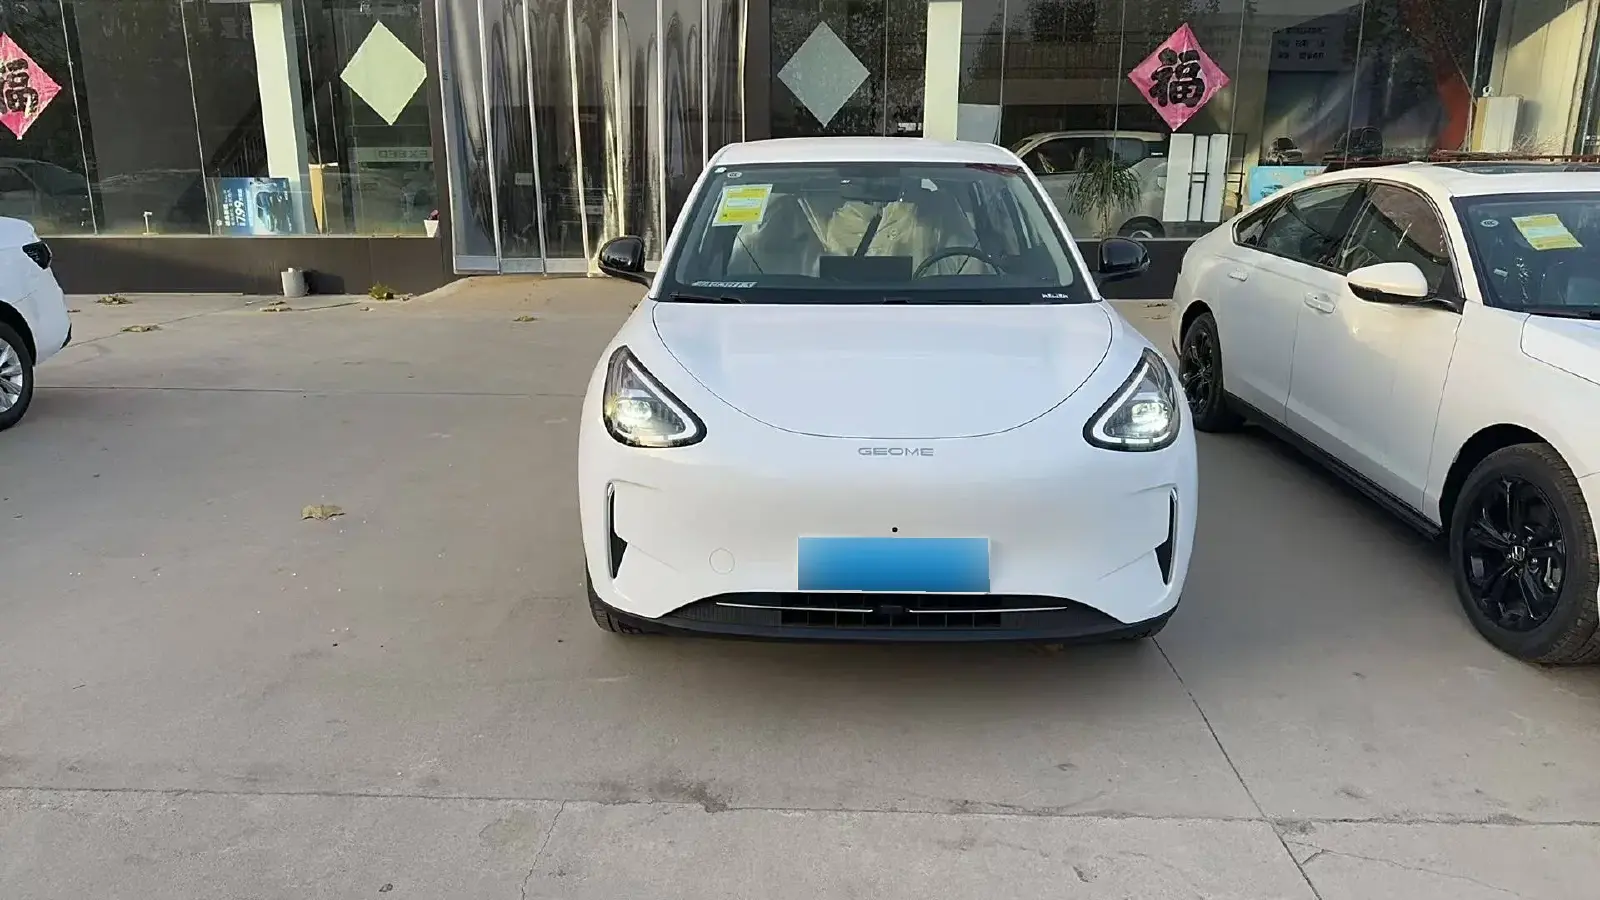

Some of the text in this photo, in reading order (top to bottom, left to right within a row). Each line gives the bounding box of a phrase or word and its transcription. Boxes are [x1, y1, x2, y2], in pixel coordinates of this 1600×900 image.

[0, 58, 39, 114] 福
[1149, 47, 1205, 107] 福
[858, 447, 934, 456] GEOME
